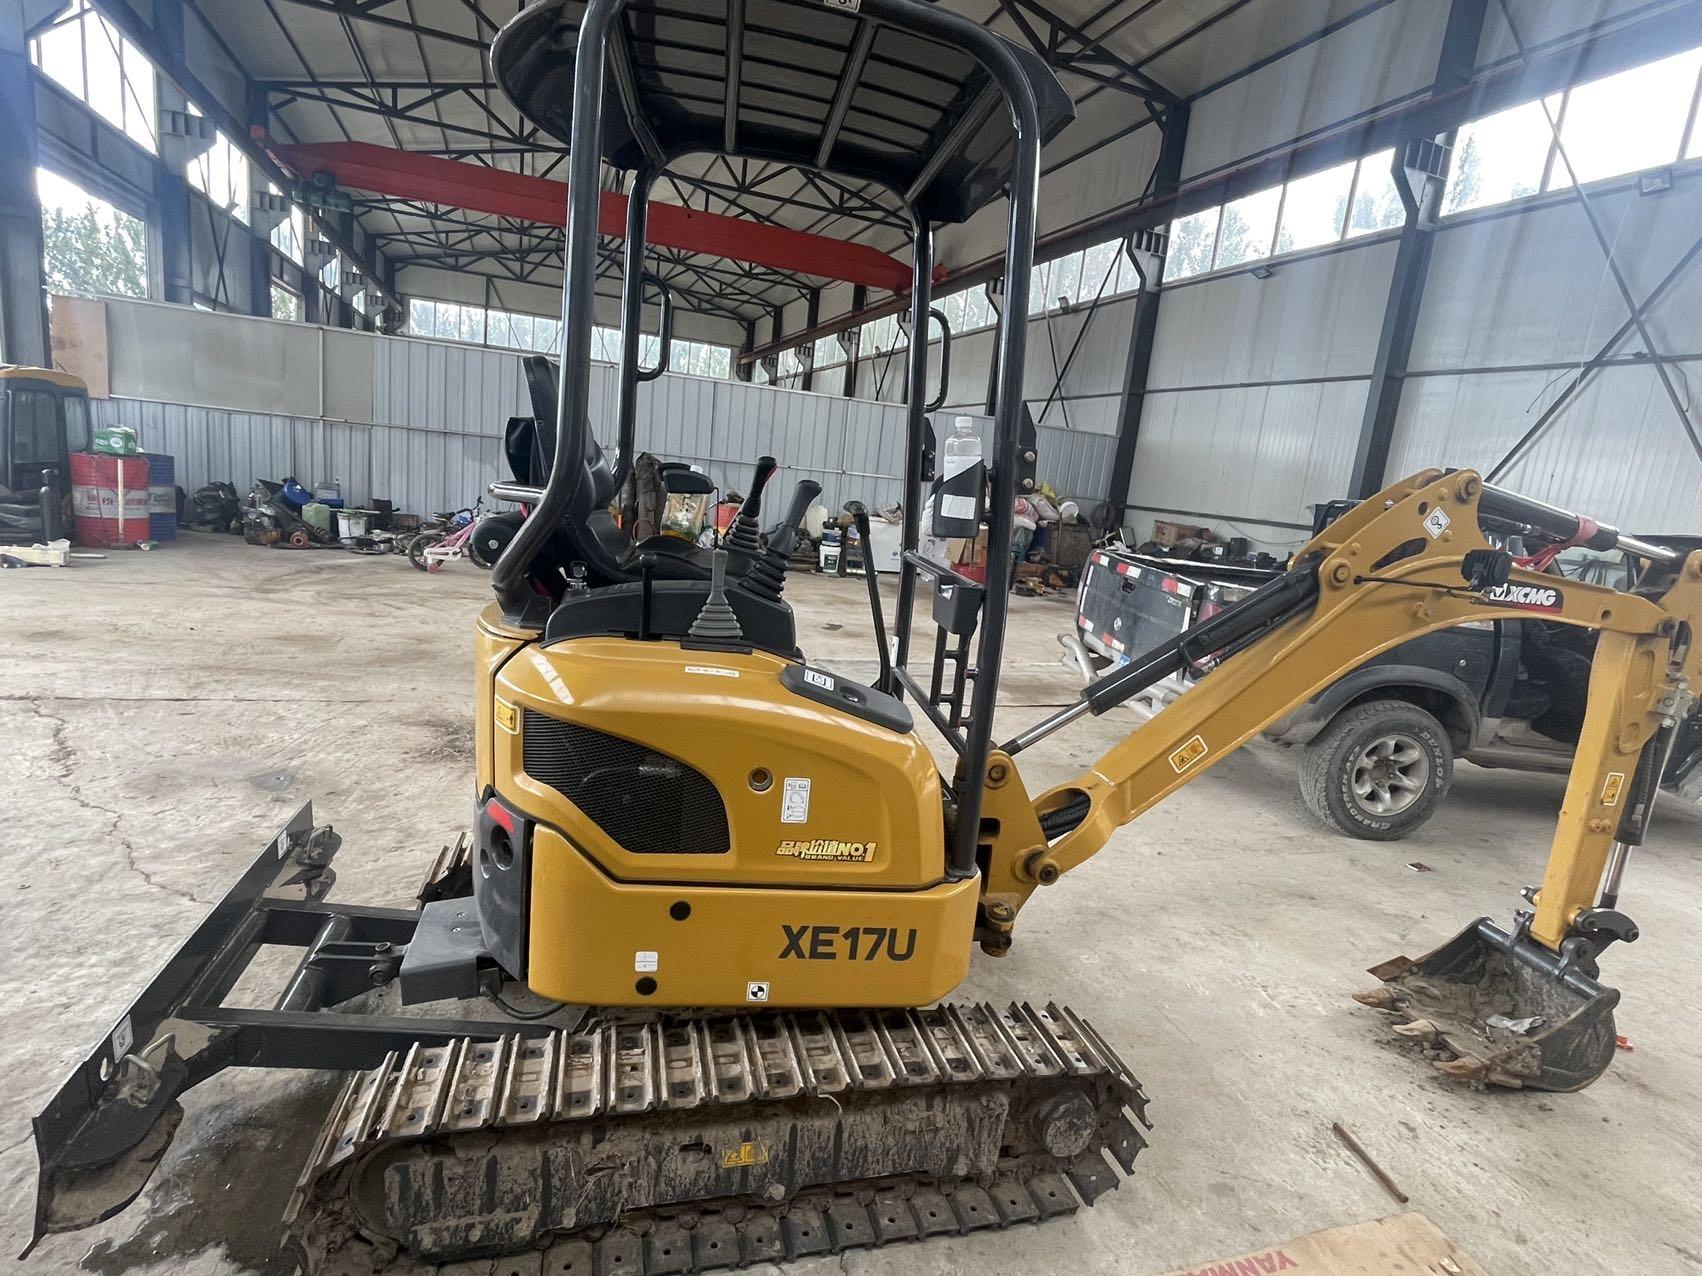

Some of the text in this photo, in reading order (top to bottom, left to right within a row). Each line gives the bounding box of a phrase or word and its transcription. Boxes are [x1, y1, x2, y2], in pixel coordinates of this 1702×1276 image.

[1504, 586, 1557, 607] XCMG
[1419, 730, 1445, 788] DUNLOP
[778, 925, 917, 961] XE17U
[1179, 1250, 1299, 1276] YANM
